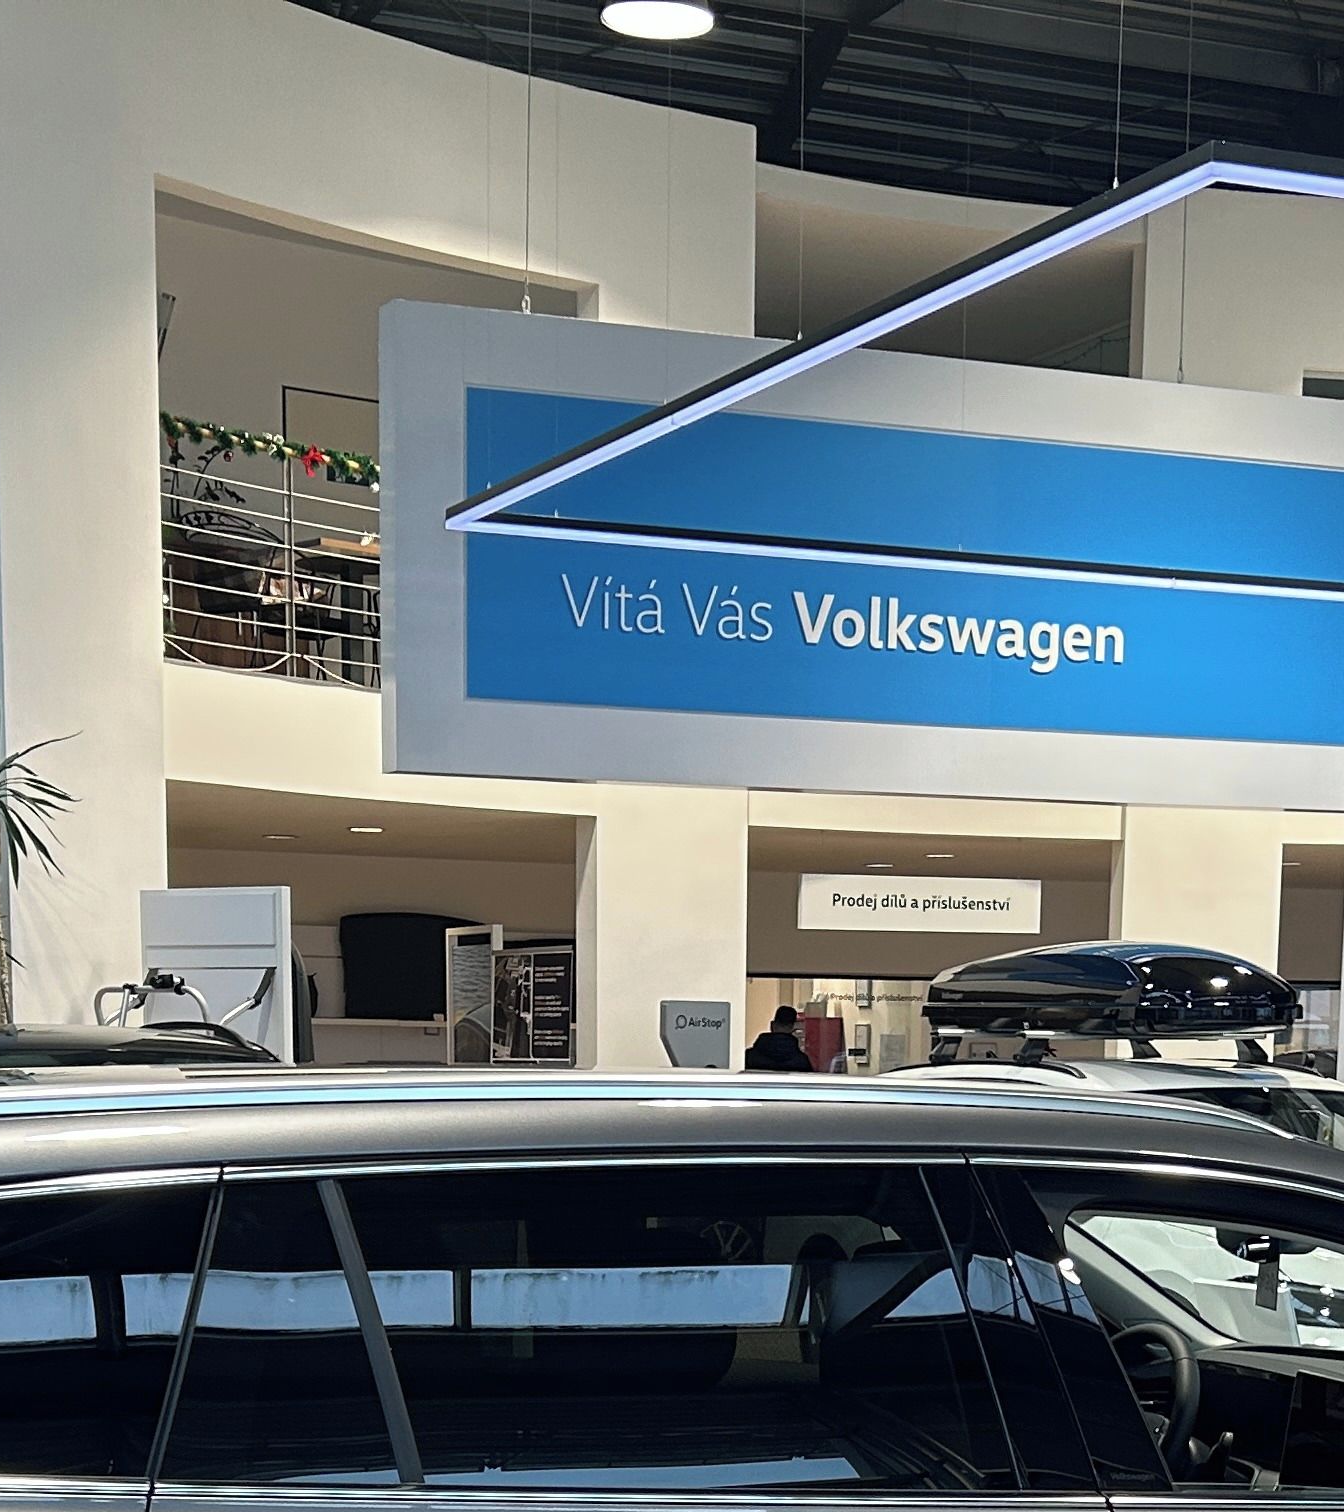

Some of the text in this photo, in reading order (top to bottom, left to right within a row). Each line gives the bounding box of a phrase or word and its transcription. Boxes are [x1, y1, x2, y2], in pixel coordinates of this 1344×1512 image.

[561, 573, 1126, 675] Vítá Vás Volkswagen
[832, 893, 1011, 912] Prodej dílů a příslušenství
